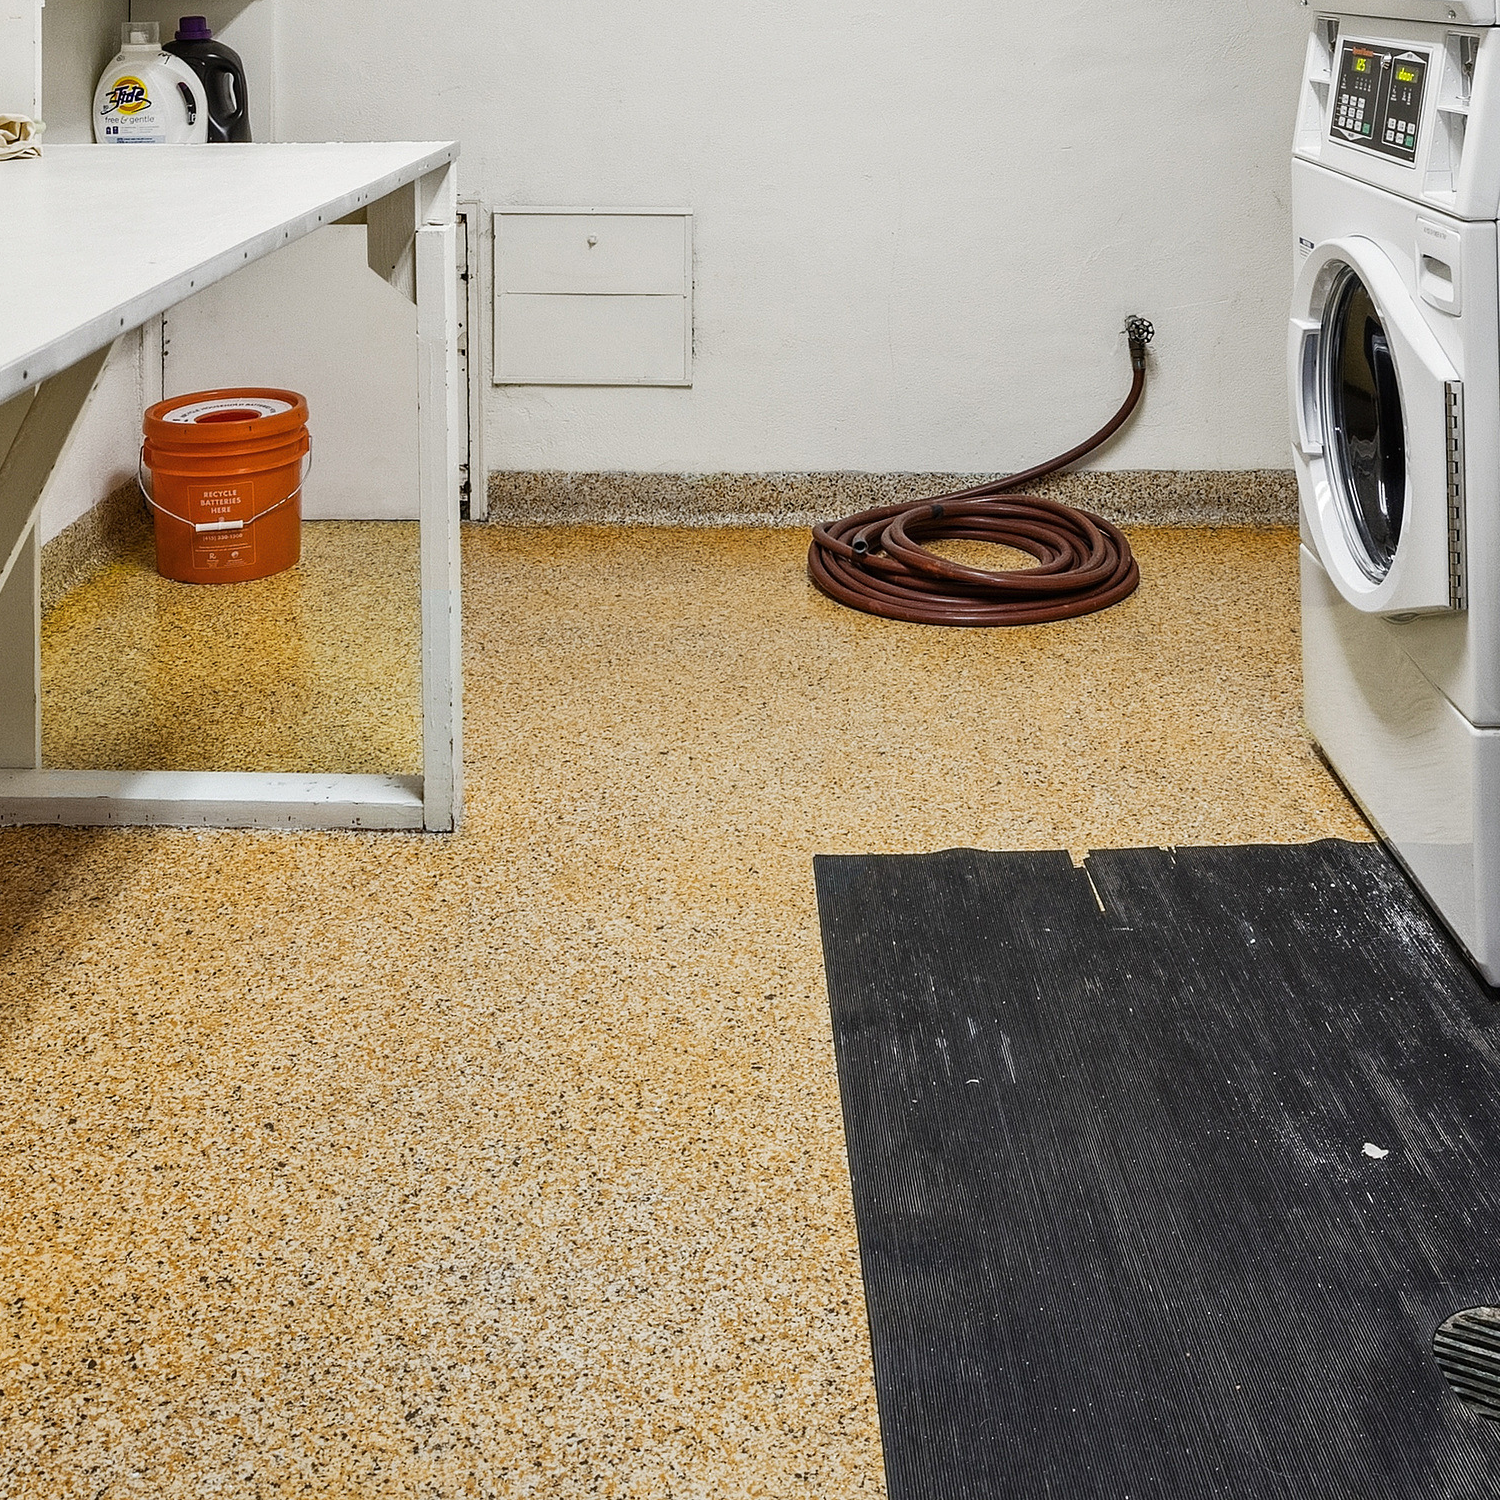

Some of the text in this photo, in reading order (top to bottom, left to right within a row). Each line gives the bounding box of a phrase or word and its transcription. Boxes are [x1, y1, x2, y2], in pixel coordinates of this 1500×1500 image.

[100, 85, 152, 115] Tide
[105, 116, 155, 125] free & gentle
[203, 489, 237, 498] RECYCLE
[200, 497, 242, 506] BATTERIES
[210, 506, 231, 514] HERE
